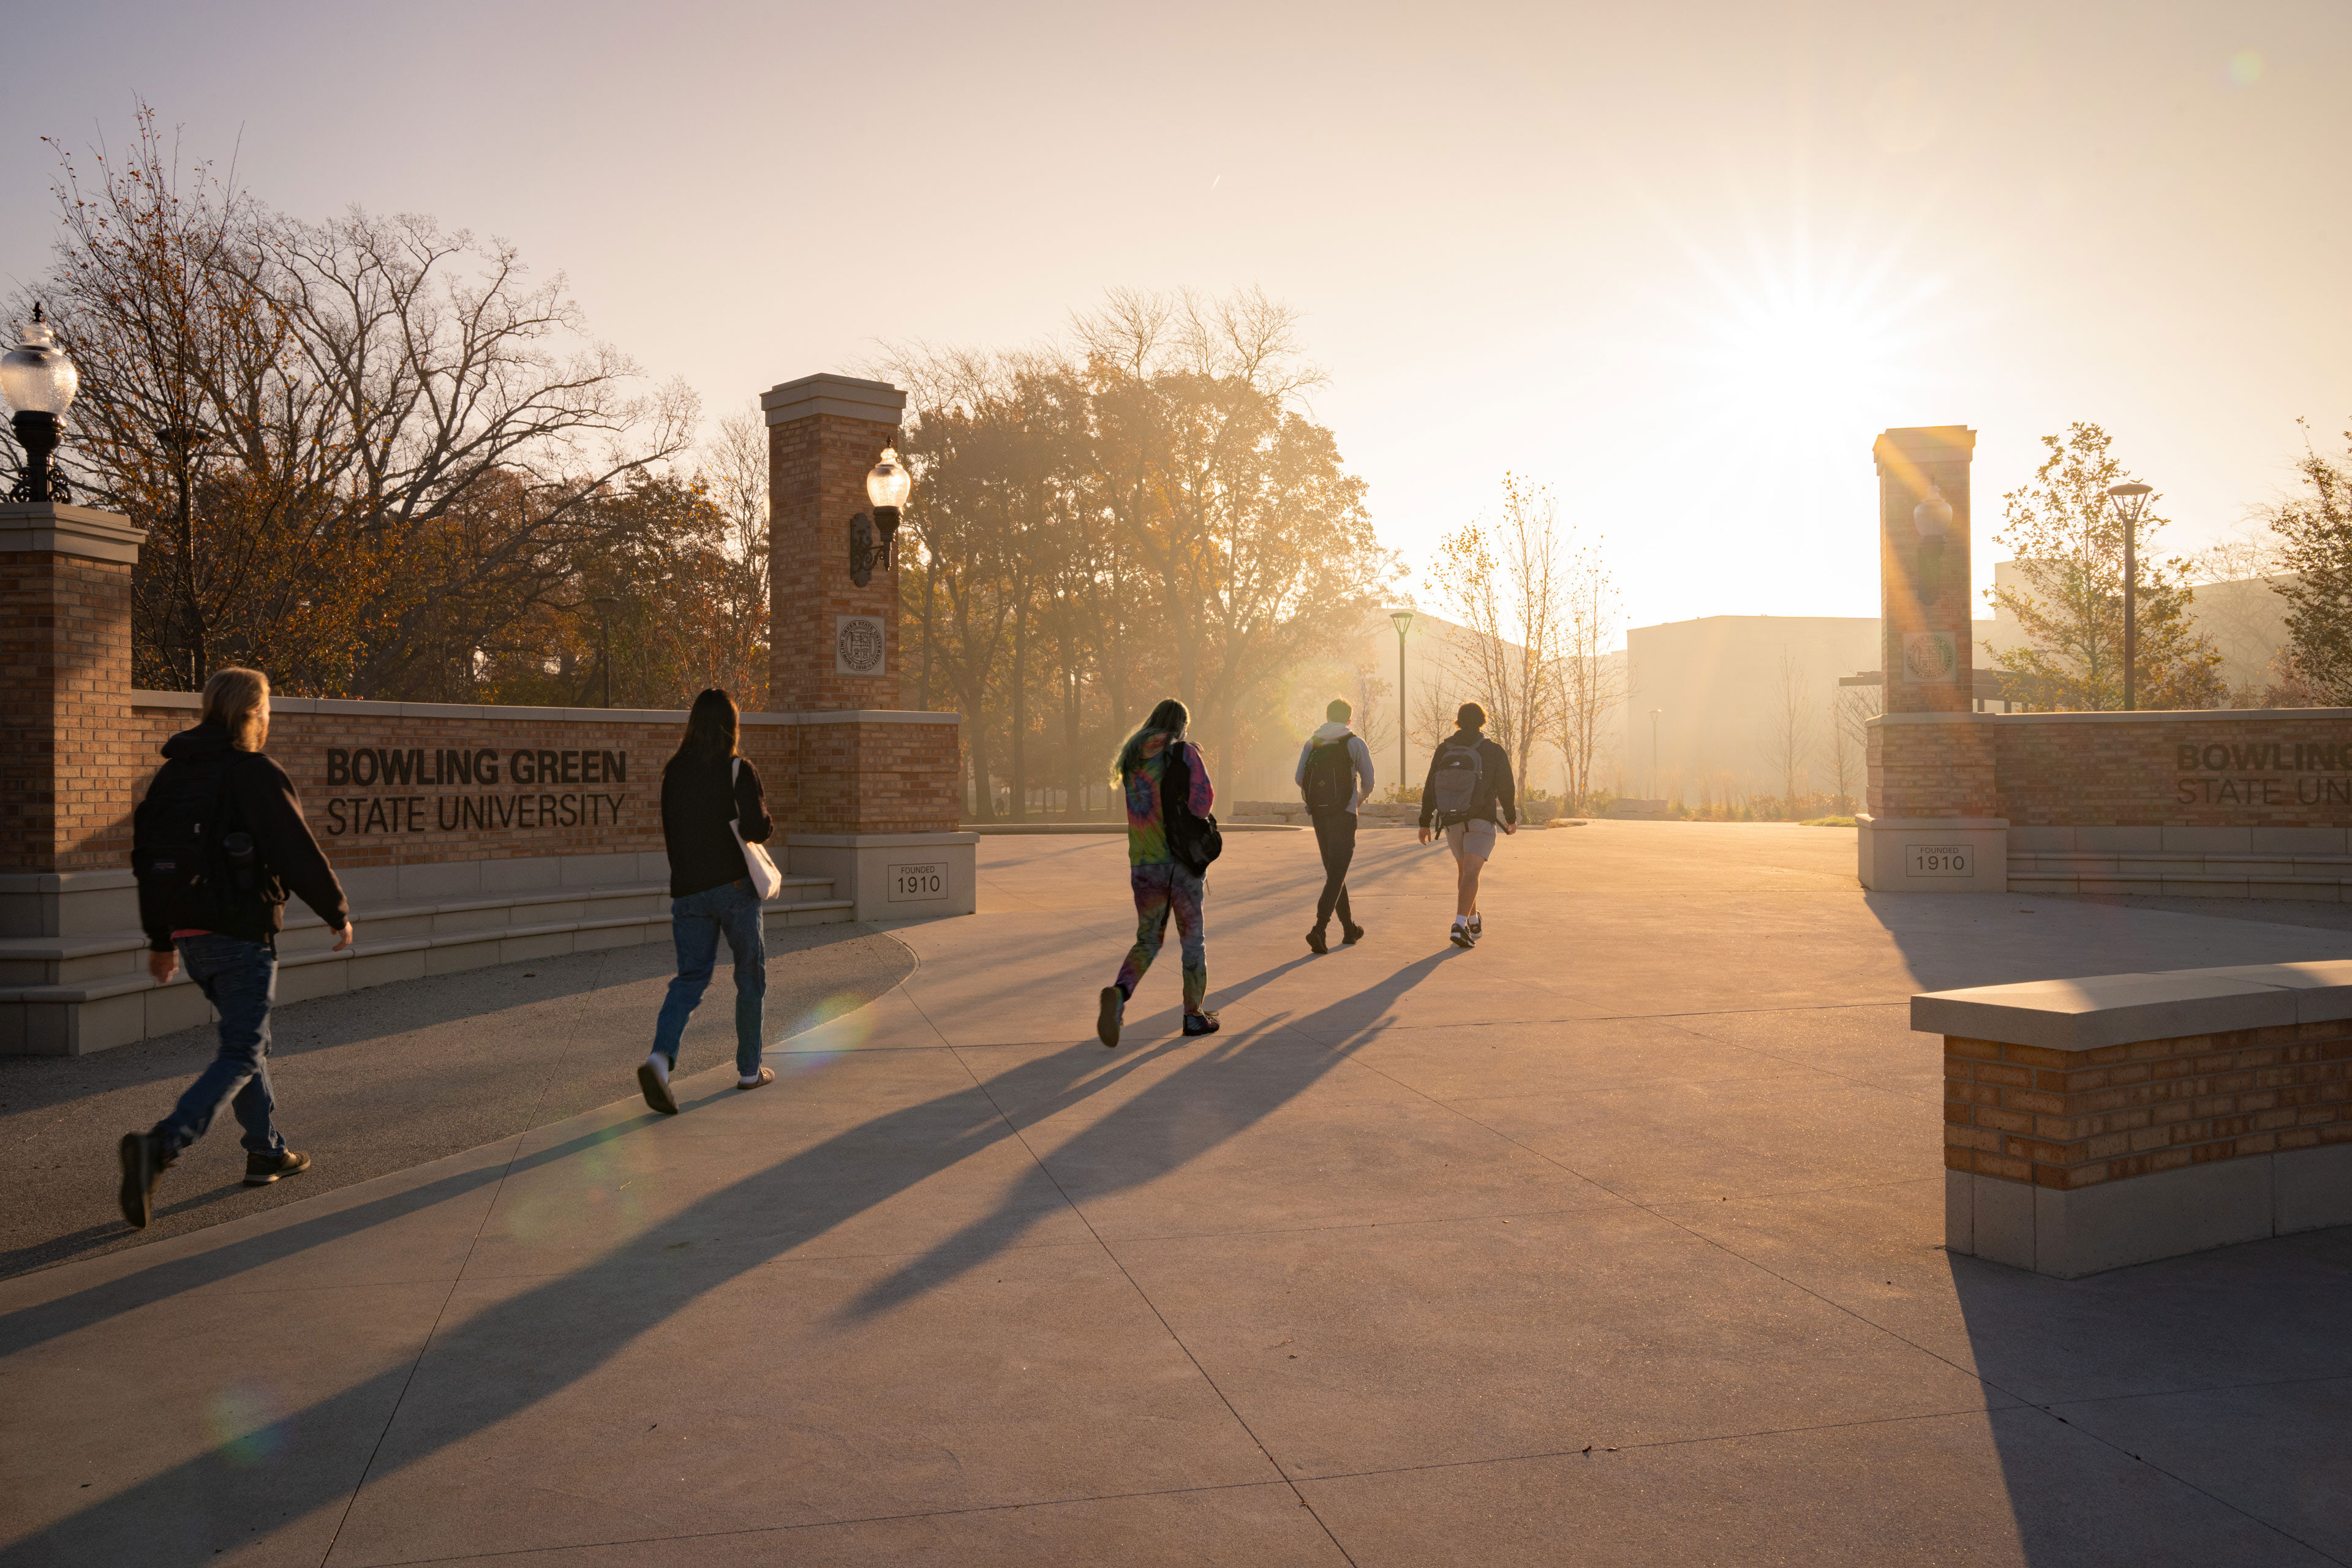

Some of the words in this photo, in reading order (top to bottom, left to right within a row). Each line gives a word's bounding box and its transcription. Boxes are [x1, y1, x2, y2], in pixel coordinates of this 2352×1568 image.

[842, 622, 857, 638] GREEN
[858, 621, 874, 631] STATE
[328, 748, 499, 786] BOWLING
[510, 749, 627, 785] GREEN
[2177, 778, 2283, 805] STATE
[327, 796, 426, 835] STATE
[439, 793, 625, 831] UNIVERSITY
[1917, 856, 1964, 870] 1910
[898, 876, 940, 893] 1910
